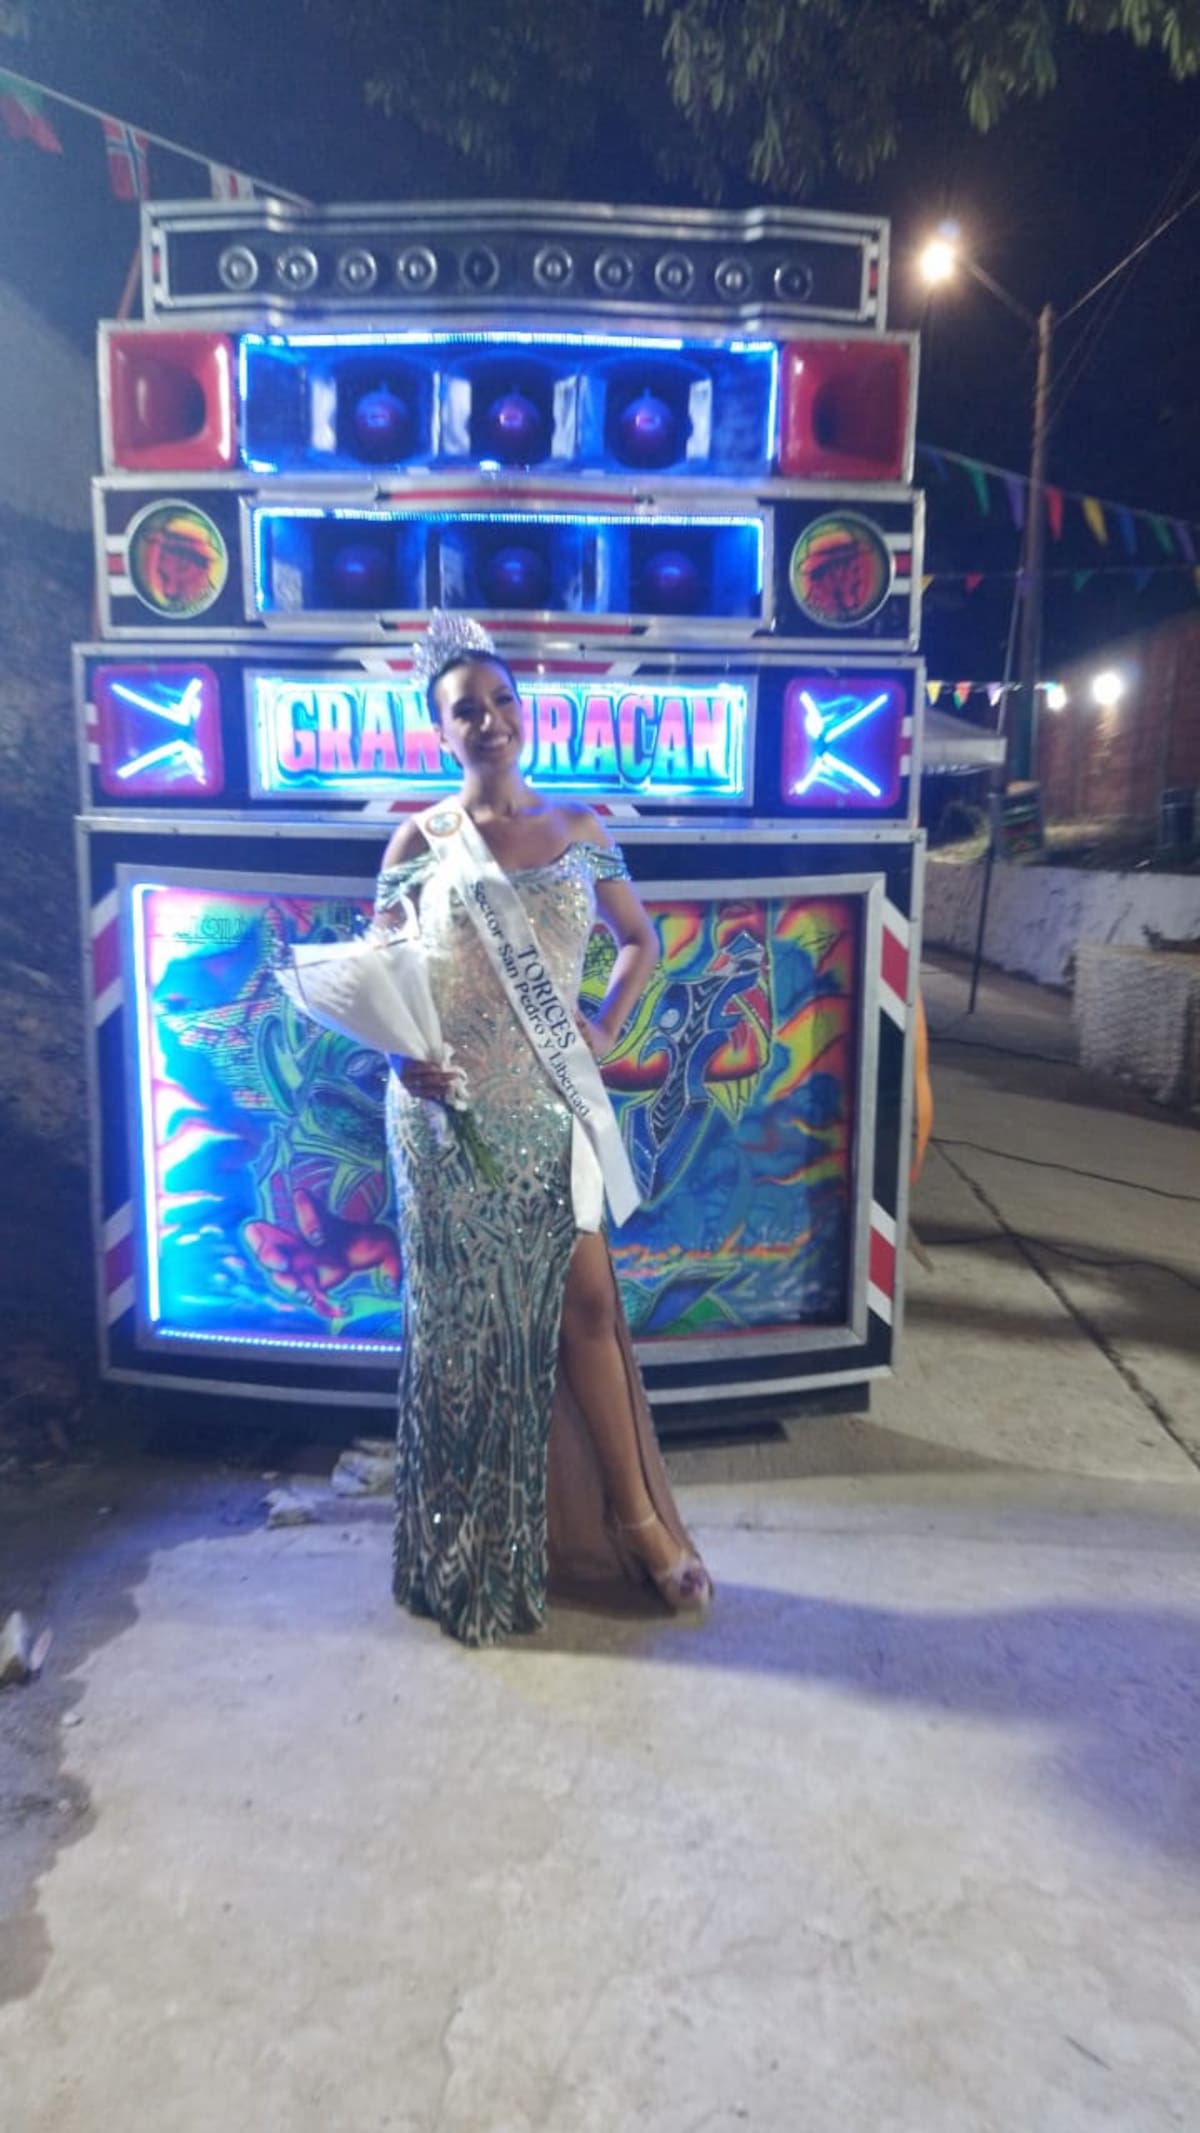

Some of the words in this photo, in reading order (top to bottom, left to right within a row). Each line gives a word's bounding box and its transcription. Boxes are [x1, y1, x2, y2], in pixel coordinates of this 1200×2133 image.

[277, 690, 441, 771] GRAN
[521, 693, 731, 778] RACAN
[473, 881, 504, 938] Sector
[499, 943, 518, 978] San
[514, 982, 545, 1035] Pedro
[538, 1038, 555, 1049] y
[549, 1052, 590, 1117] Libertad
[518, 944, 575, 1048] TORICES
